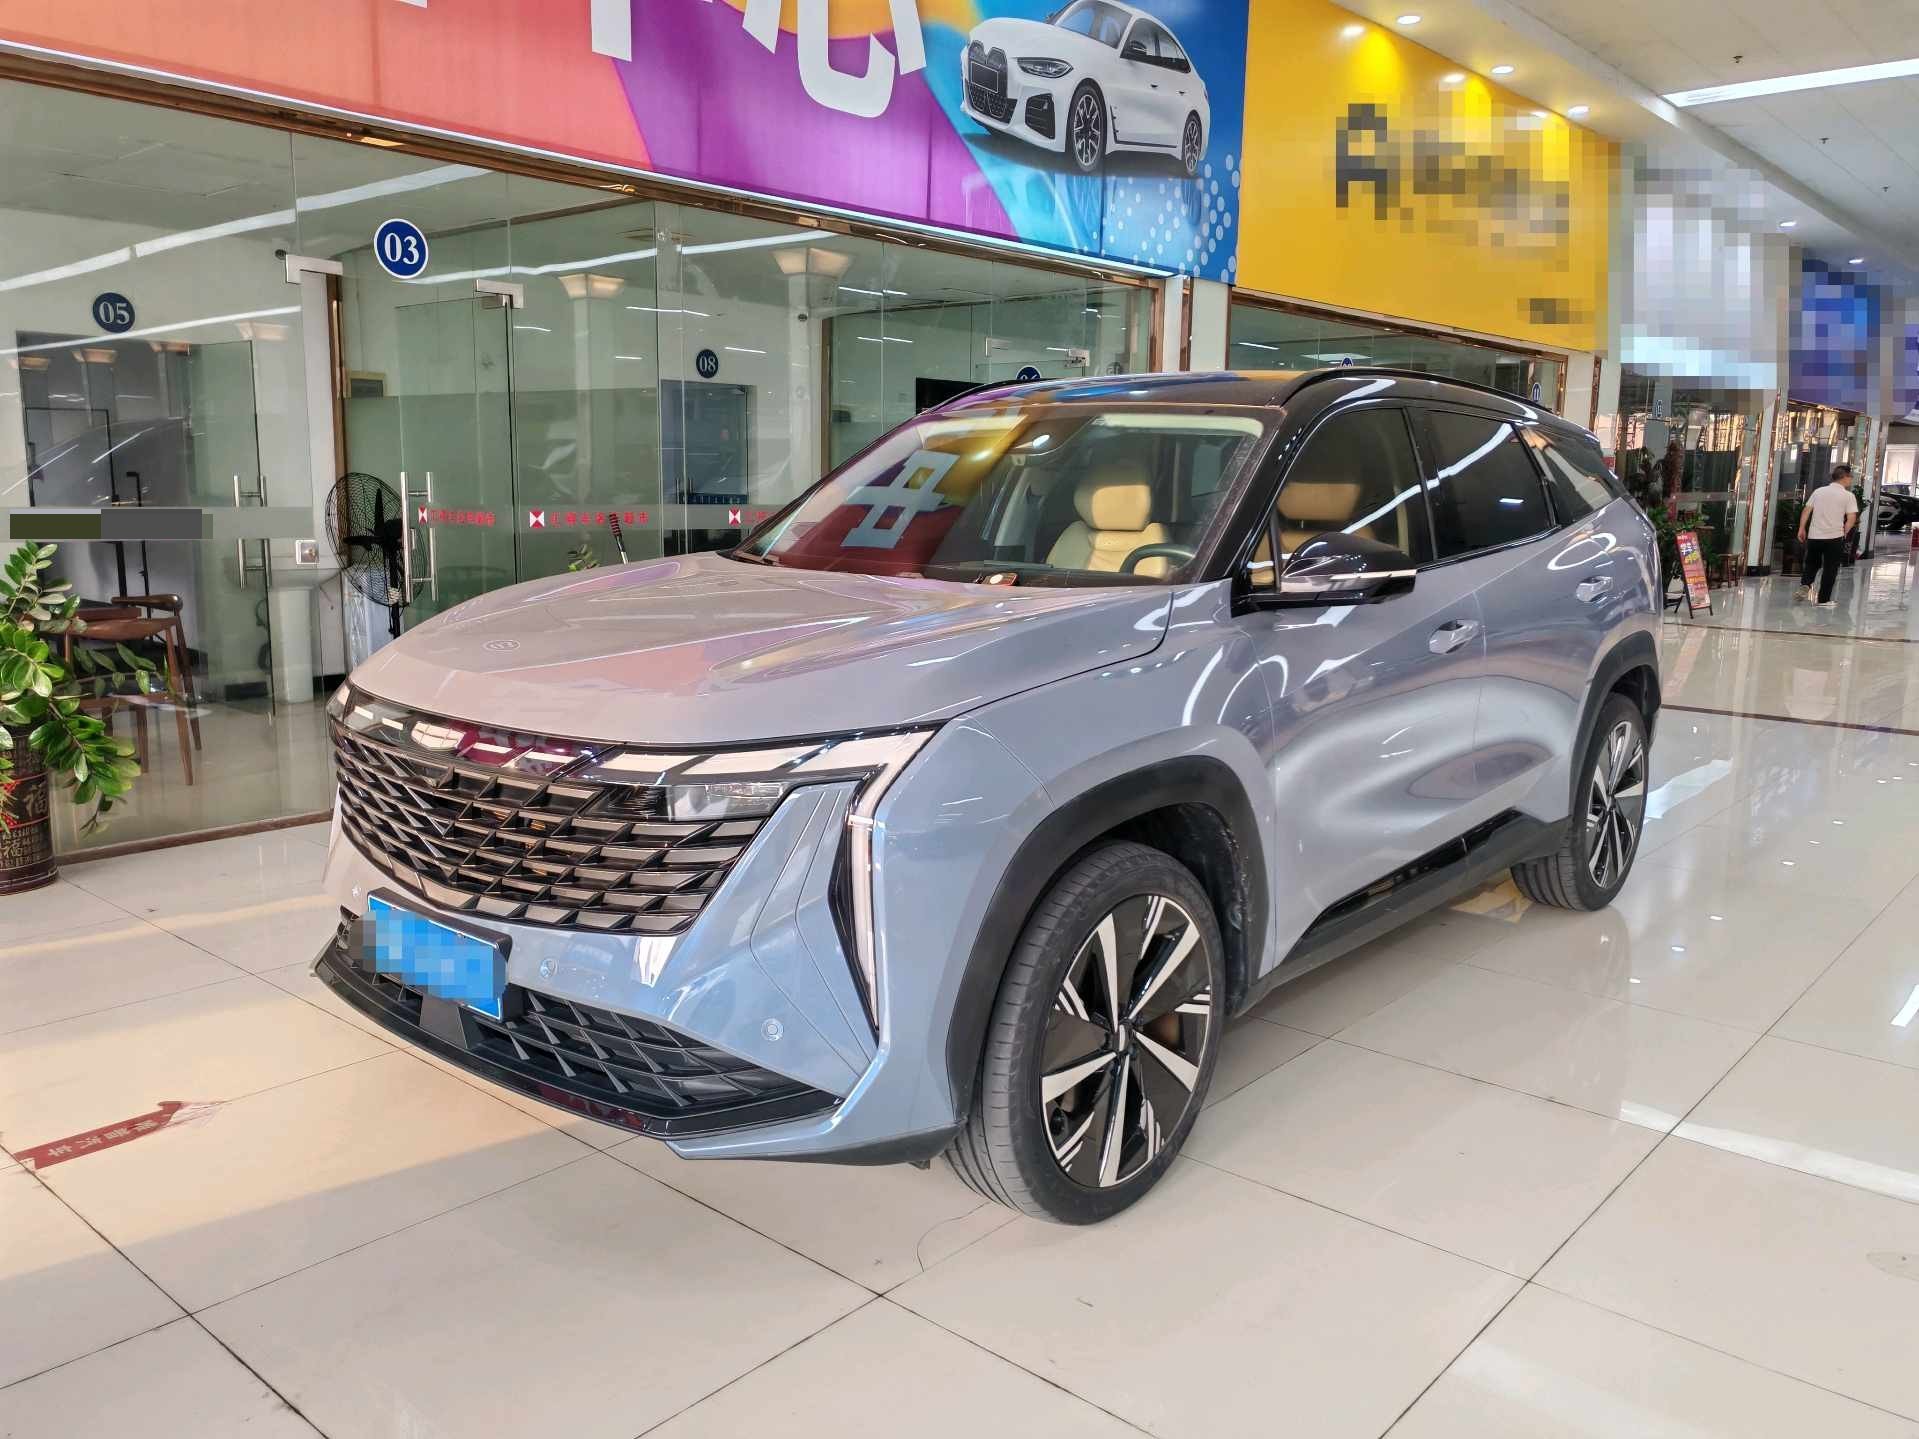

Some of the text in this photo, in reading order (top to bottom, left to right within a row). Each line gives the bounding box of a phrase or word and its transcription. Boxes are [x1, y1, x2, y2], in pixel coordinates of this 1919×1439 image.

[384, 232, 420, 265] 03
[98, 301, 130, 325] 05
[699, 355, 717, 373] 08
